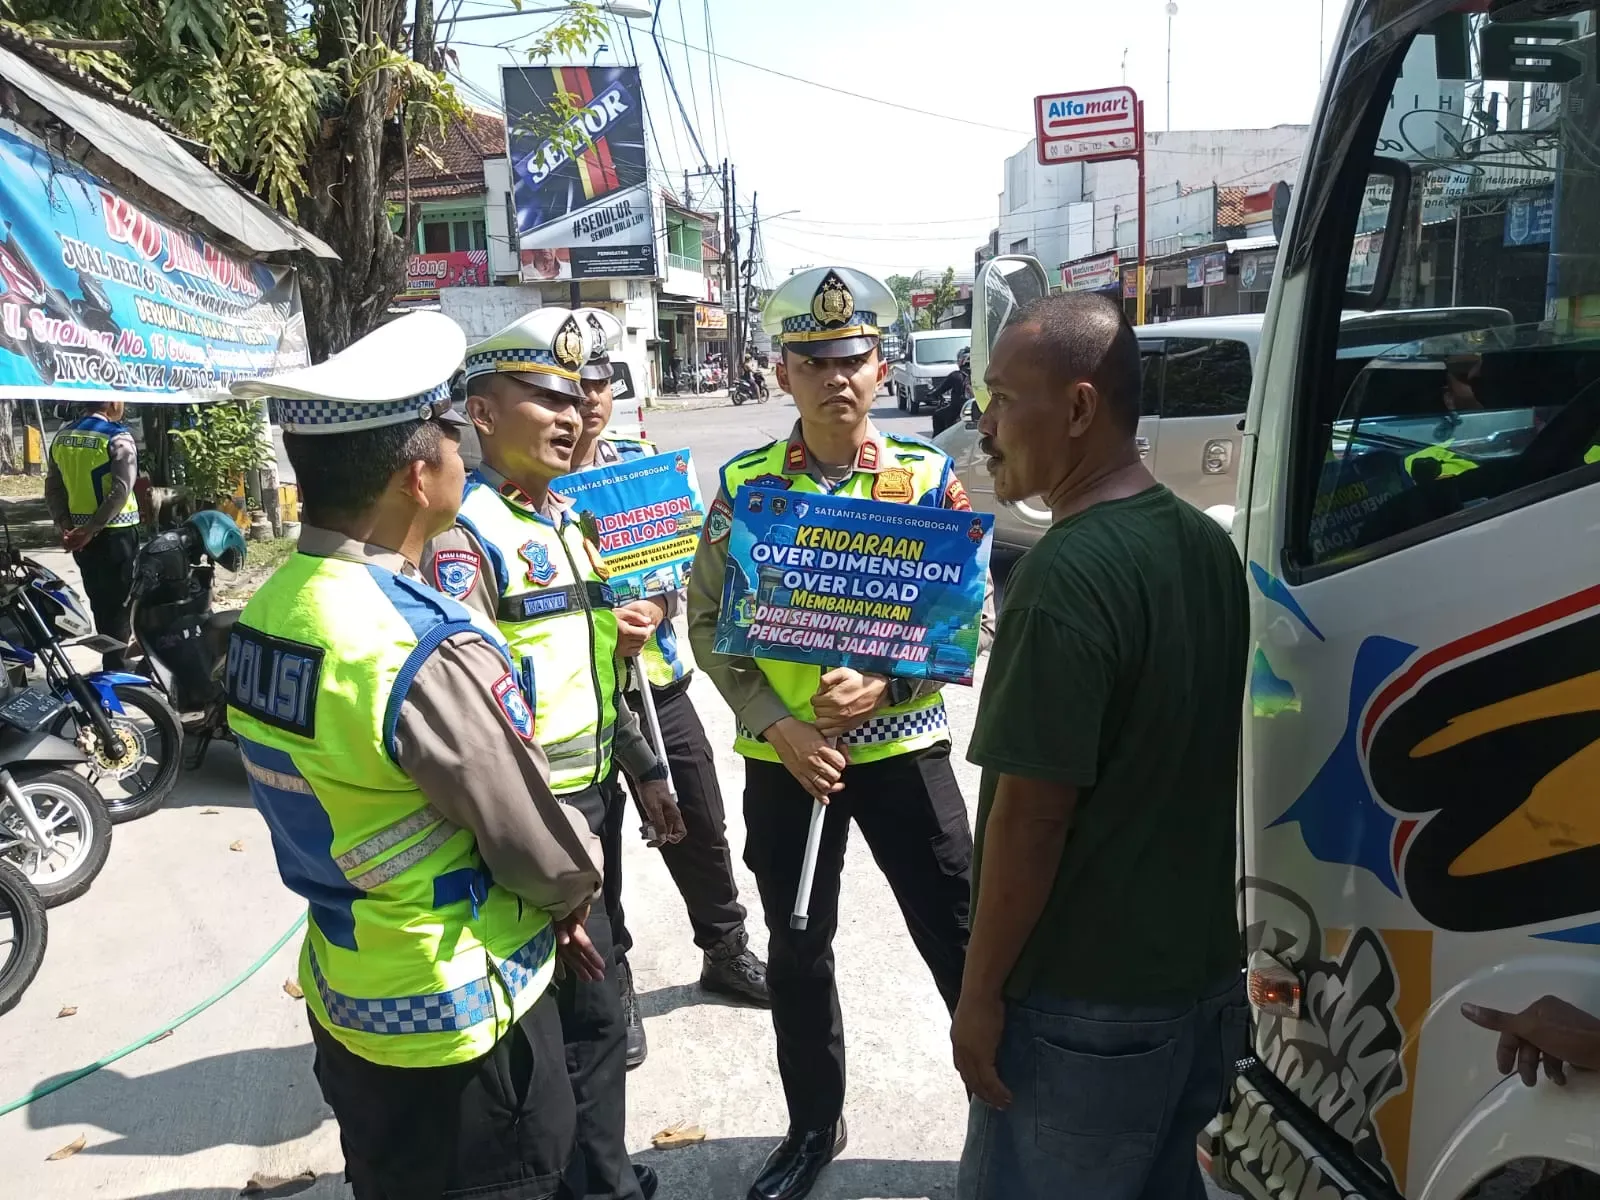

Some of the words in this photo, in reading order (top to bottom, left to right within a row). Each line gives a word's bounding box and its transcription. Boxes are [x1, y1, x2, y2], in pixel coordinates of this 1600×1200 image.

[1048, 95, 1129, 118] Alfamart
[573, 200, 632, 239] #SEDULUR
[590, 225, 614, 242] SENIOR
[62, 239, 108, 281] JUAL
[108, 254, 143, 291] BELI
[115, 330, 147, 356] No.
[151, 336, 167, 360] 15
[57, 435, 100, 449] POLISI
[559, 480, 602, 496] SATLANTAS
[602, 474, 629, 487] POLRES
[629, 465, 669, 480] GROBOGAN
[604, 496, 692, 532] DIMENSION
[814, 507, 868, 521] SATLANTAS
[868, 513, 903, 526] POLRES
[904, 518, 959, 532] GROBOGAN
[598, 529, 634, 551] VER
[633, 517, 678, 543] LOAD
[796, 527, 925, 560] KENDARAAN
[752, 544, 816, 568] OVER
[820, 551, 962, 583] DIMENSION
[783, 571, 846, 595] OVER
[852, 579, 919, 602] LOAD
[756, 605, 789, 624] DIRI
[790, 611, 852, 634] SENDIRI
[854, 618, 926, 642] MAUPUN
[747, 624, 834, 650] PENGGUNA
[836, 637, 889, 657] JALAN
[890, 644, 928, 661] LAIN
[226, 632, 315, 727] POLISI
